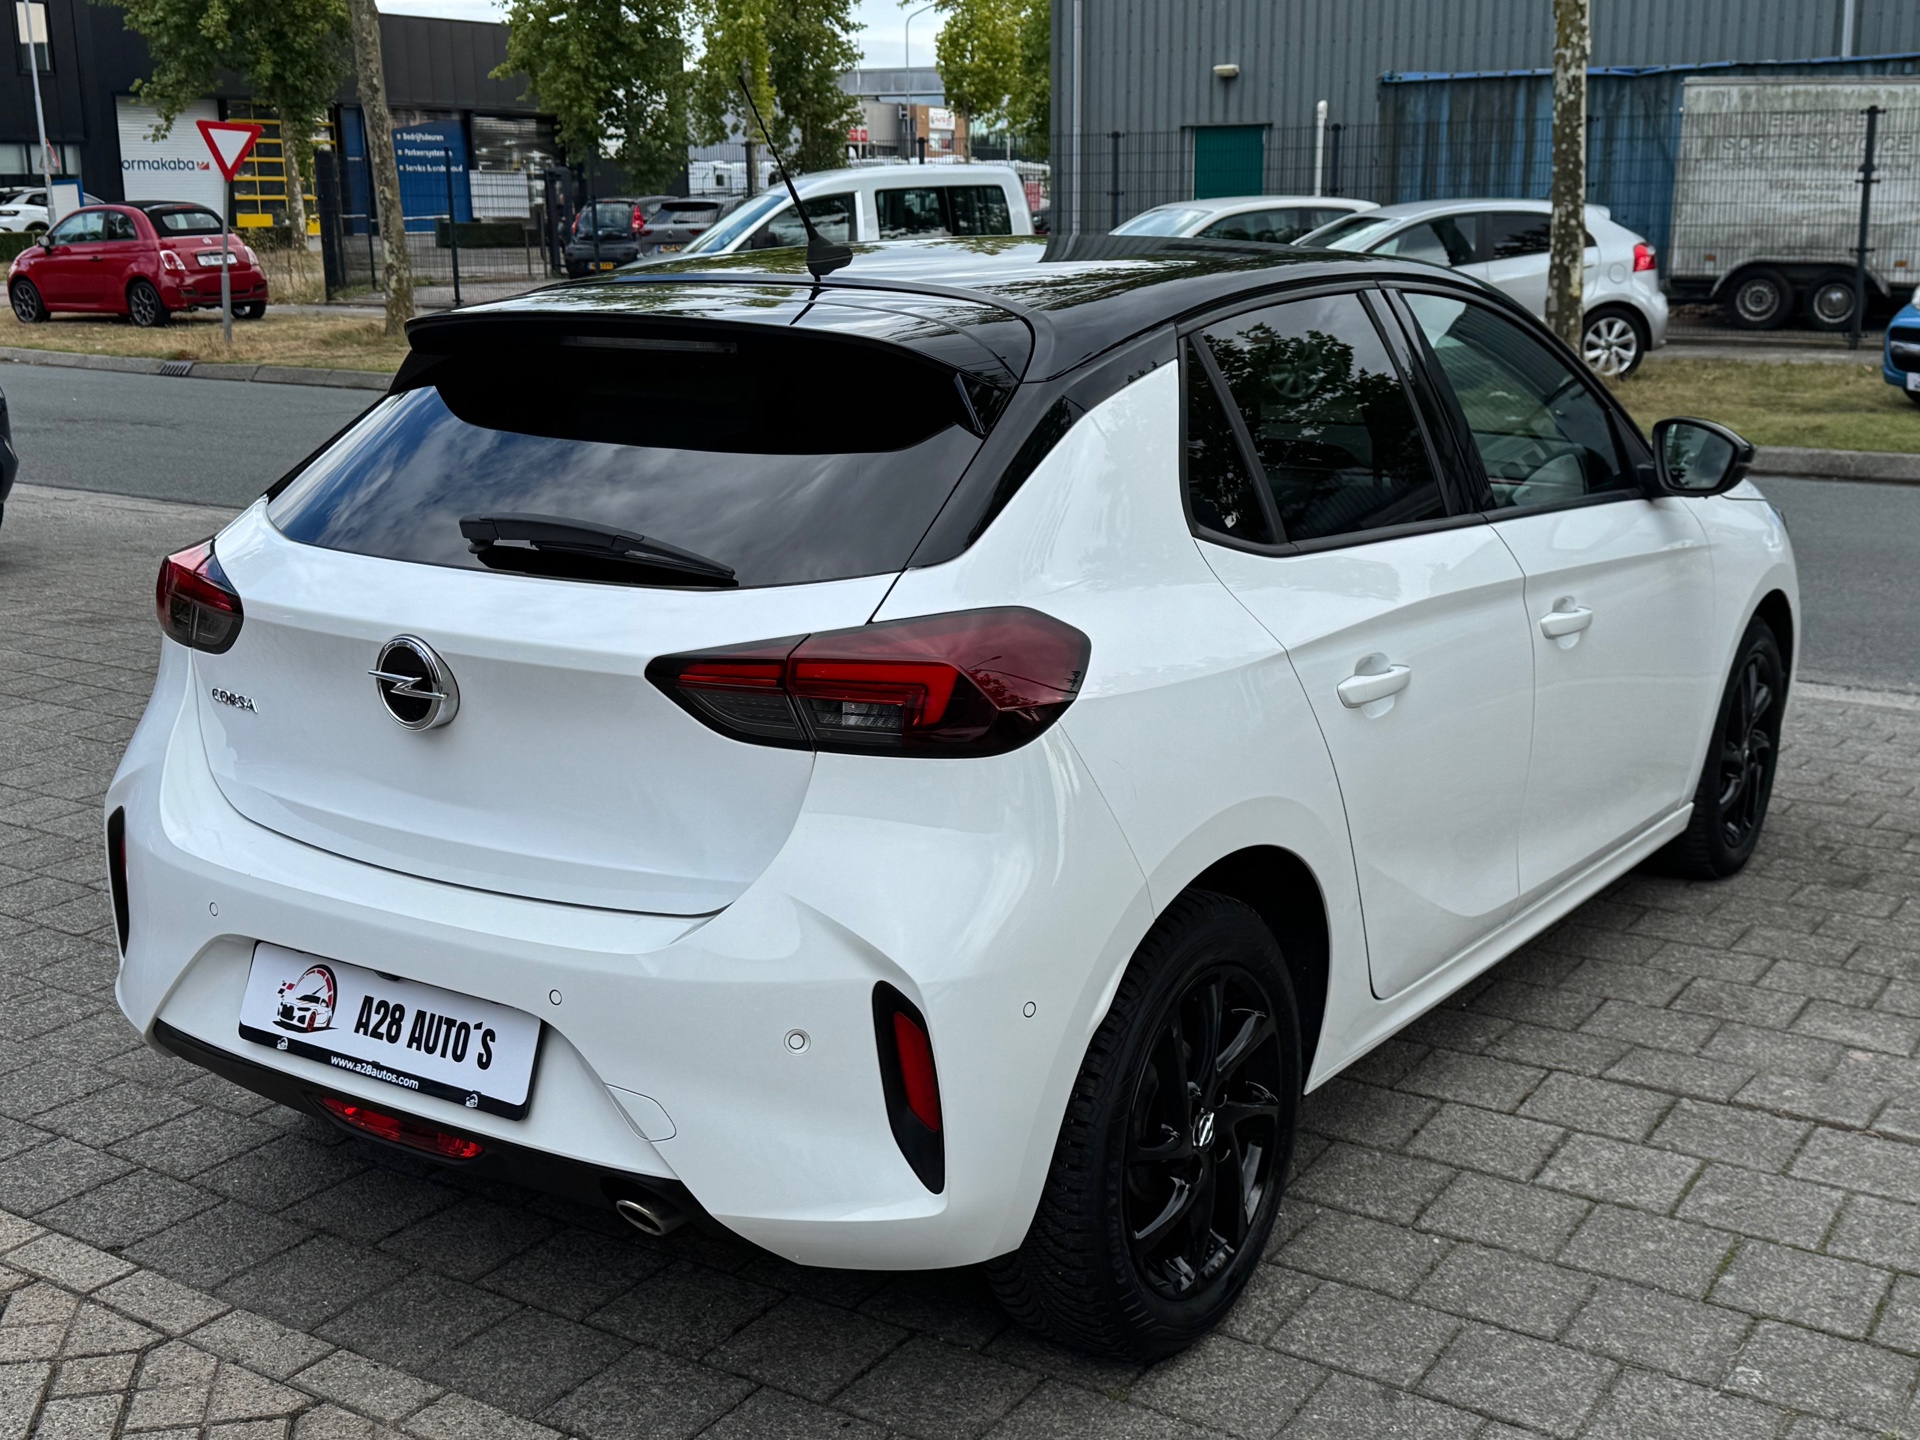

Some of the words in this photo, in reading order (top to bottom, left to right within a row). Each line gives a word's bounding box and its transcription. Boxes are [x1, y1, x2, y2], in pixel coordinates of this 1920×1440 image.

[403, 132, 444, 142] Bedrijfsdeuren
[404, 148, 453, 158] Parkeersystemn
[212, 687, 258, 714] CORSA
[354, 995, 405, 1044] A28
[330, 1054, 420, 1091] www.a28autos.com
